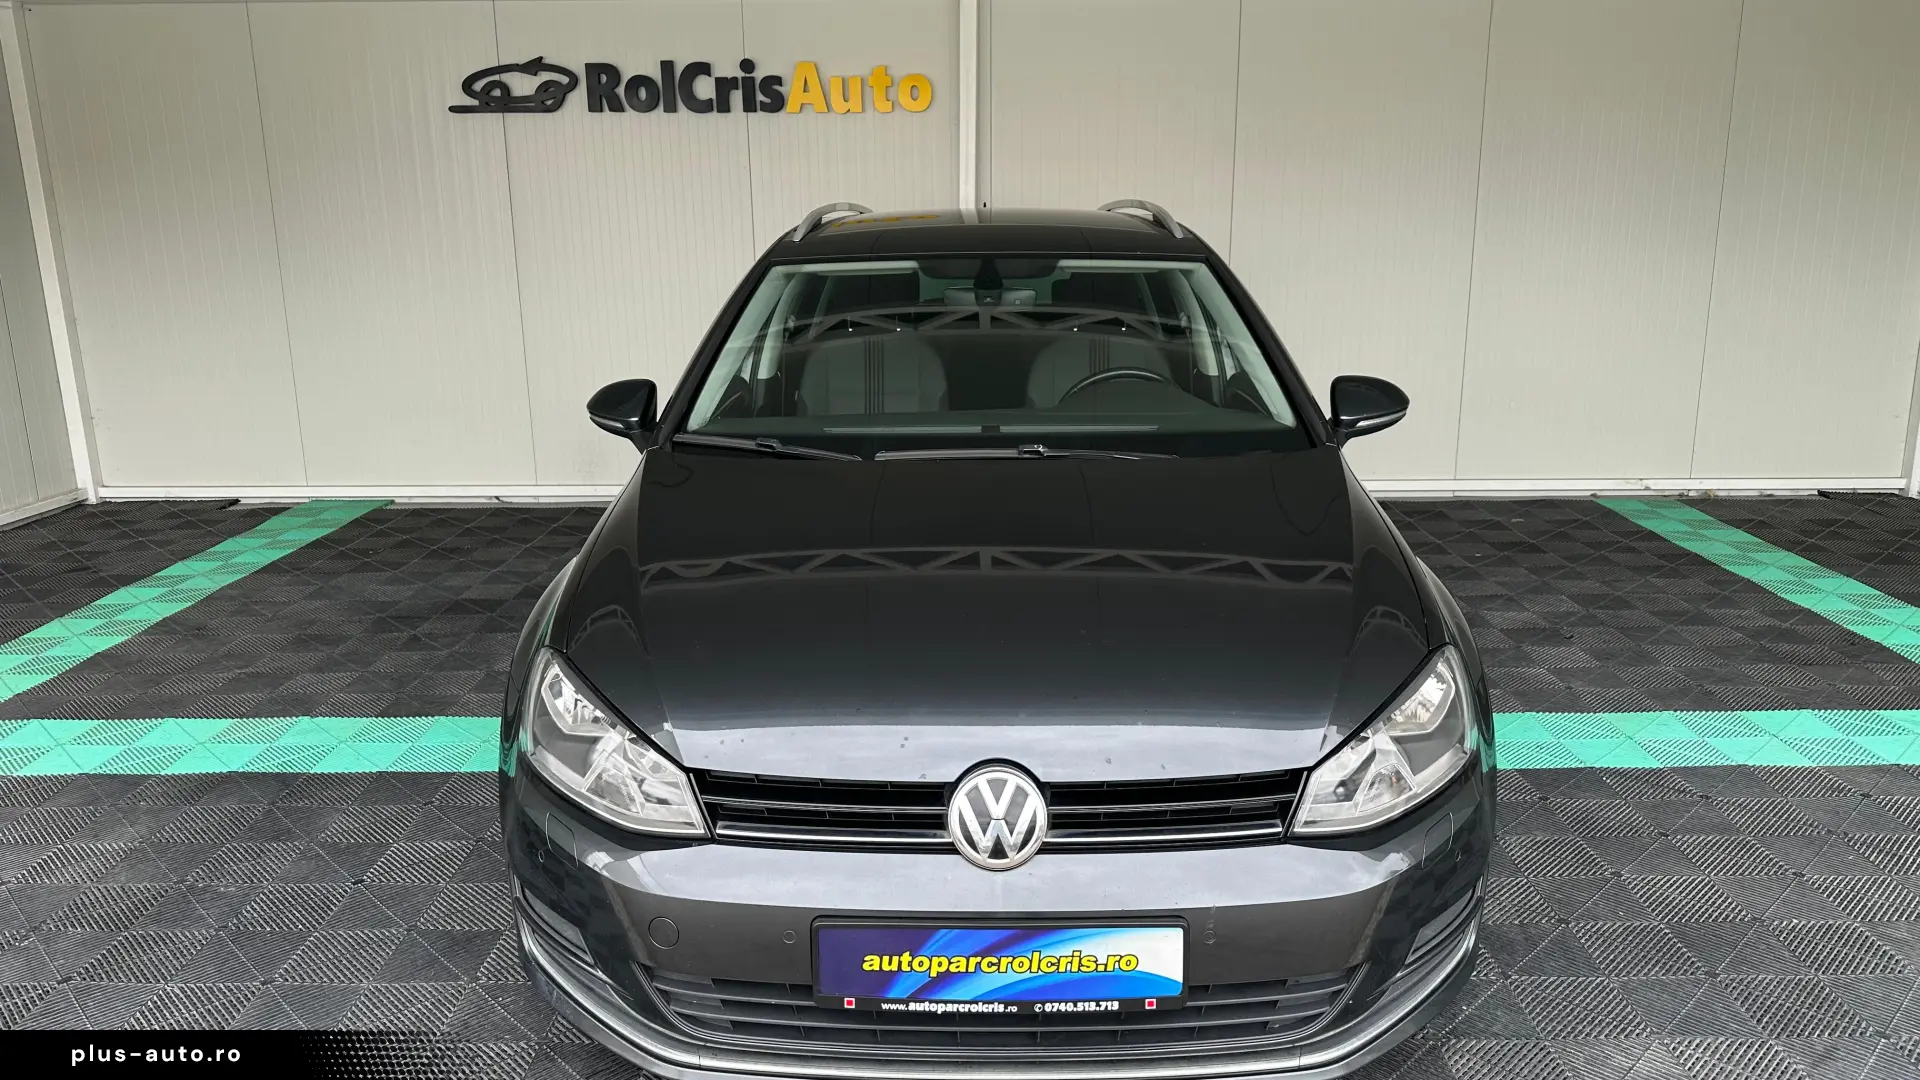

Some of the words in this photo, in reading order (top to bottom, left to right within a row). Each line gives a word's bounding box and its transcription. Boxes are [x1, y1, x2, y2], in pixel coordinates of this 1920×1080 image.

[584, 58, 934, 114] RolCrisAuto
[951, 768, 1043, 867] VW
[861, 950, 1139, 978] autoparcrolcris.ro
[881, 1001, 1018, 1014] www.autoparcrolcris.ro
[1044, 1001, 1119, 1012] 0740.513.713
